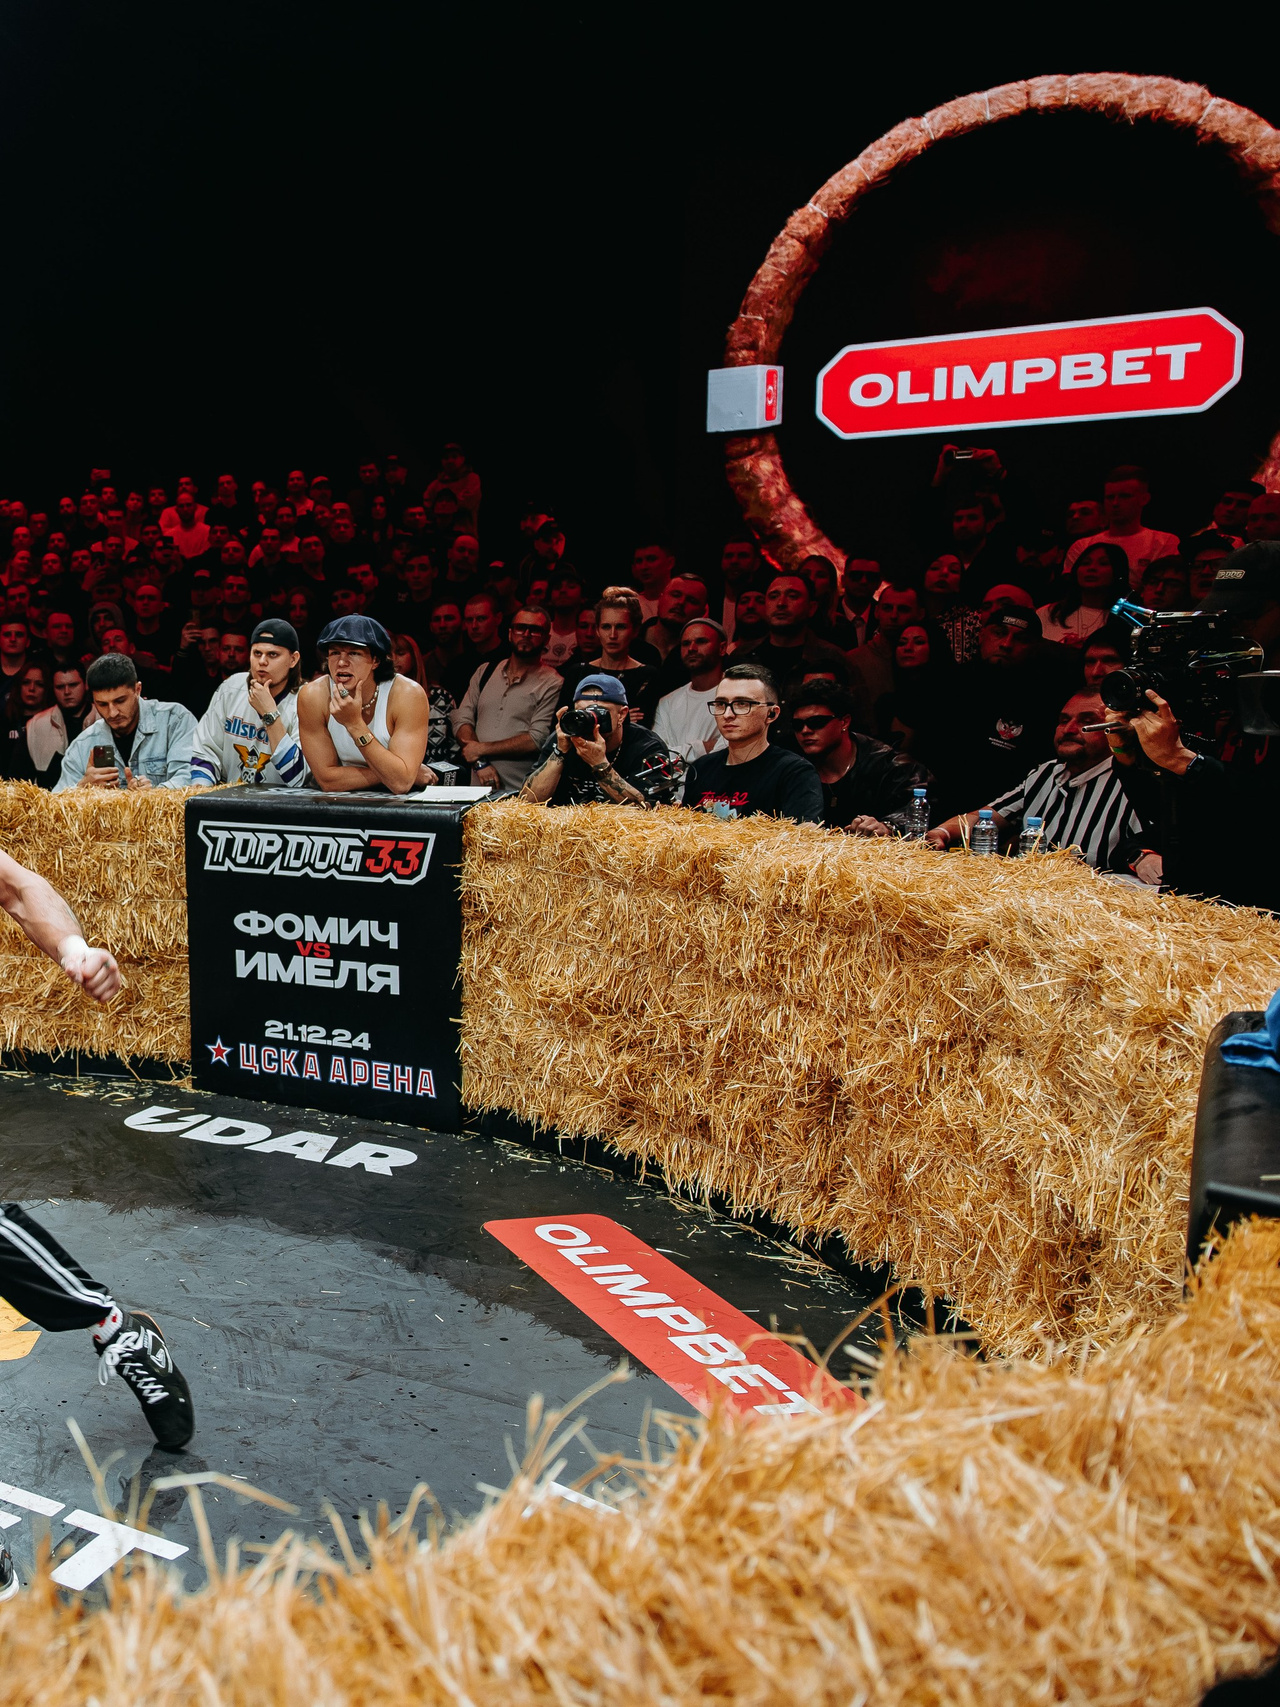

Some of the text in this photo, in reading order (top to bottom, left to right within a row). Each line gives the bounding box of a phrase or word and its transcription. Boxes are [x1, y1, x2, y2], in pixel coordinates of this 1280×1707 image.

[848, 342, 1202, 407] OLIMPBET
[233, 910, 399, 950] ФОМИЧ
[295, 940, 331, 959] VS
[234, 949, 401, 996] ИМЕЛЯ
[263, 1020, 372, 1051] 21.12.24
[238, 1042, 438, 1099] ЦСКА АРЕНА
[123, 1105, 419, 1177] UDAR
[534, 1223, 823, 1416] OLIMPBET
